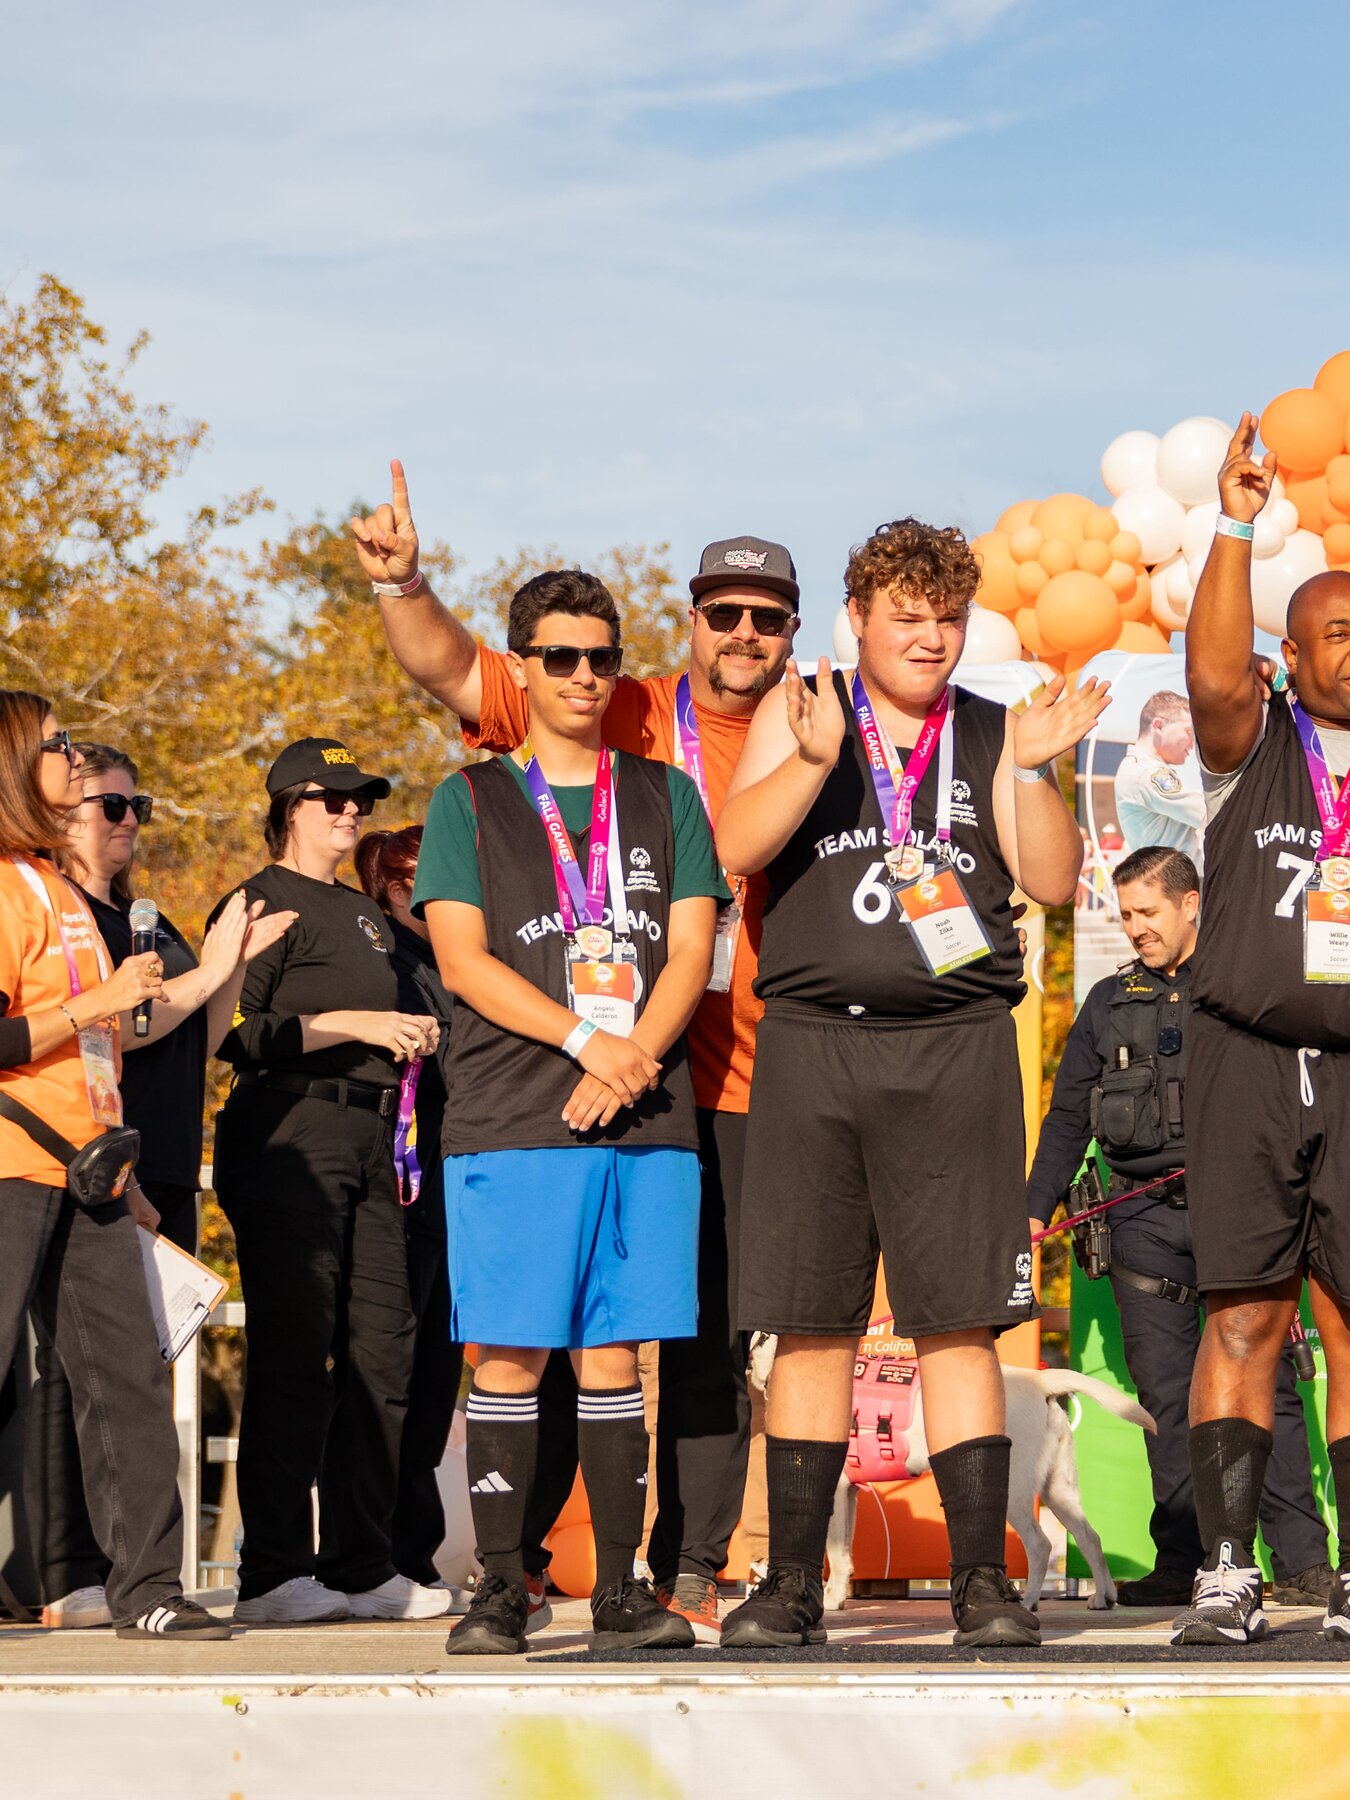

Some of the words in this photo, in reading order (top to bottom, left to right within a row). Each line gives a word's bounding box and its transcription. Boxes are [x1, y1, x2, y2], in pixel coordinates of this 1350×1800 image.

[858, 706, 871, 731] FALL
[865, 731, 885, 770] GAMES
[323, 753, 356, 765] PROBA
[950, 803, 974, 811] pecial
[537, 793, 552, 822] FALL
[548, 823, 573, 863] GAMES
[1254, 822, 1306, 849] TEAM
[814, 826, 878, 859] TEAM
[629, 870, 655, 878] Special
[852, 862, 935, 925] 6
[935, 919, 951, 928] Noah
[939, 926, 954, 935] Zilka
[1330, 931, 1349, 939] Willie
[1328, 939, 1349, 947] Weary
[593, 1005, 615, 1013] Angelo
[875, 1339, 916, 1354] Californ
[853, 1363, 866, 1377] 9
[882, 1365, 915, 1374] SERVICE
